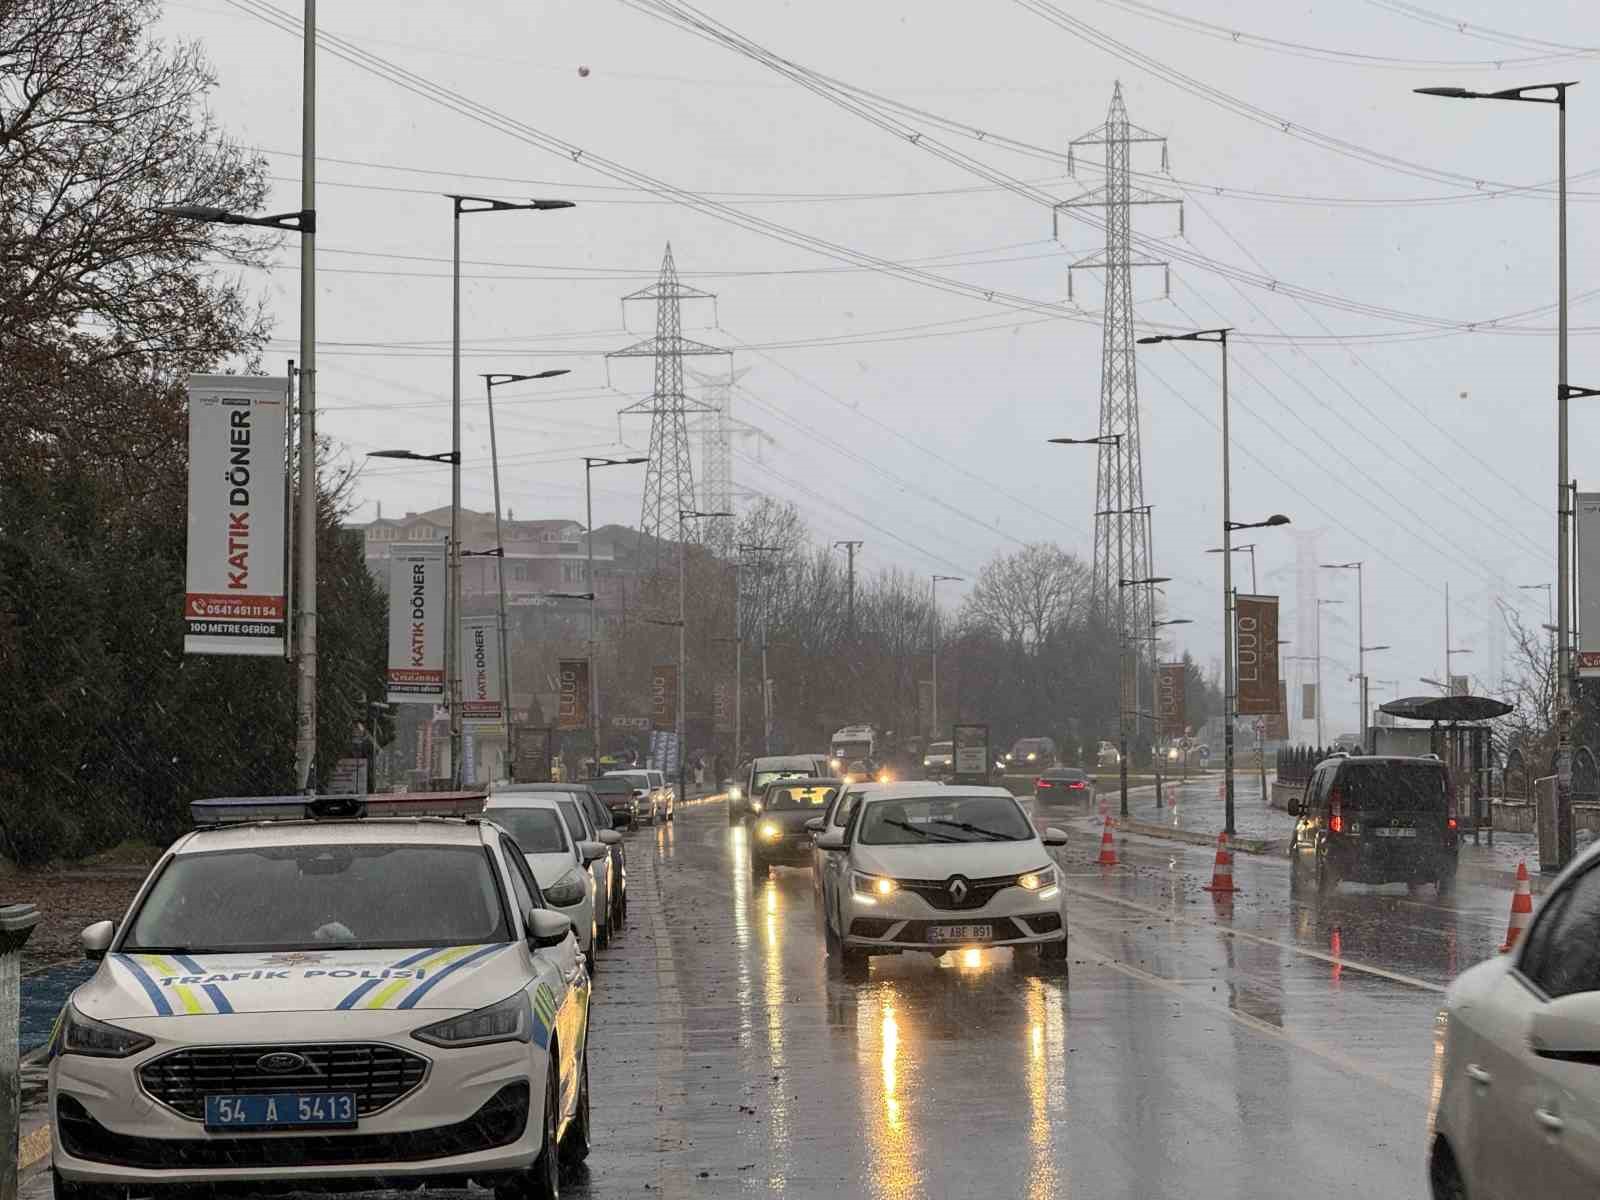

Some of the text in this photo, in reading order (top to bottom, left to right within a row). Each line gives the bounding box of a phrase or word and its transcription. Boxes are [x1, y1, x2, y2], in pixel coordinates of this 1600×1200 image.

[225, 410, 250, 506] DÖNER
[228, 512, 249, 589] KATIK
[190, 622, 208, 632] 100
[208, 623, 241, 633] METRE
[410, 564, 424, 666] KATIK DÖNER
[219, 1095, 351, 1122] 54 A 5413
